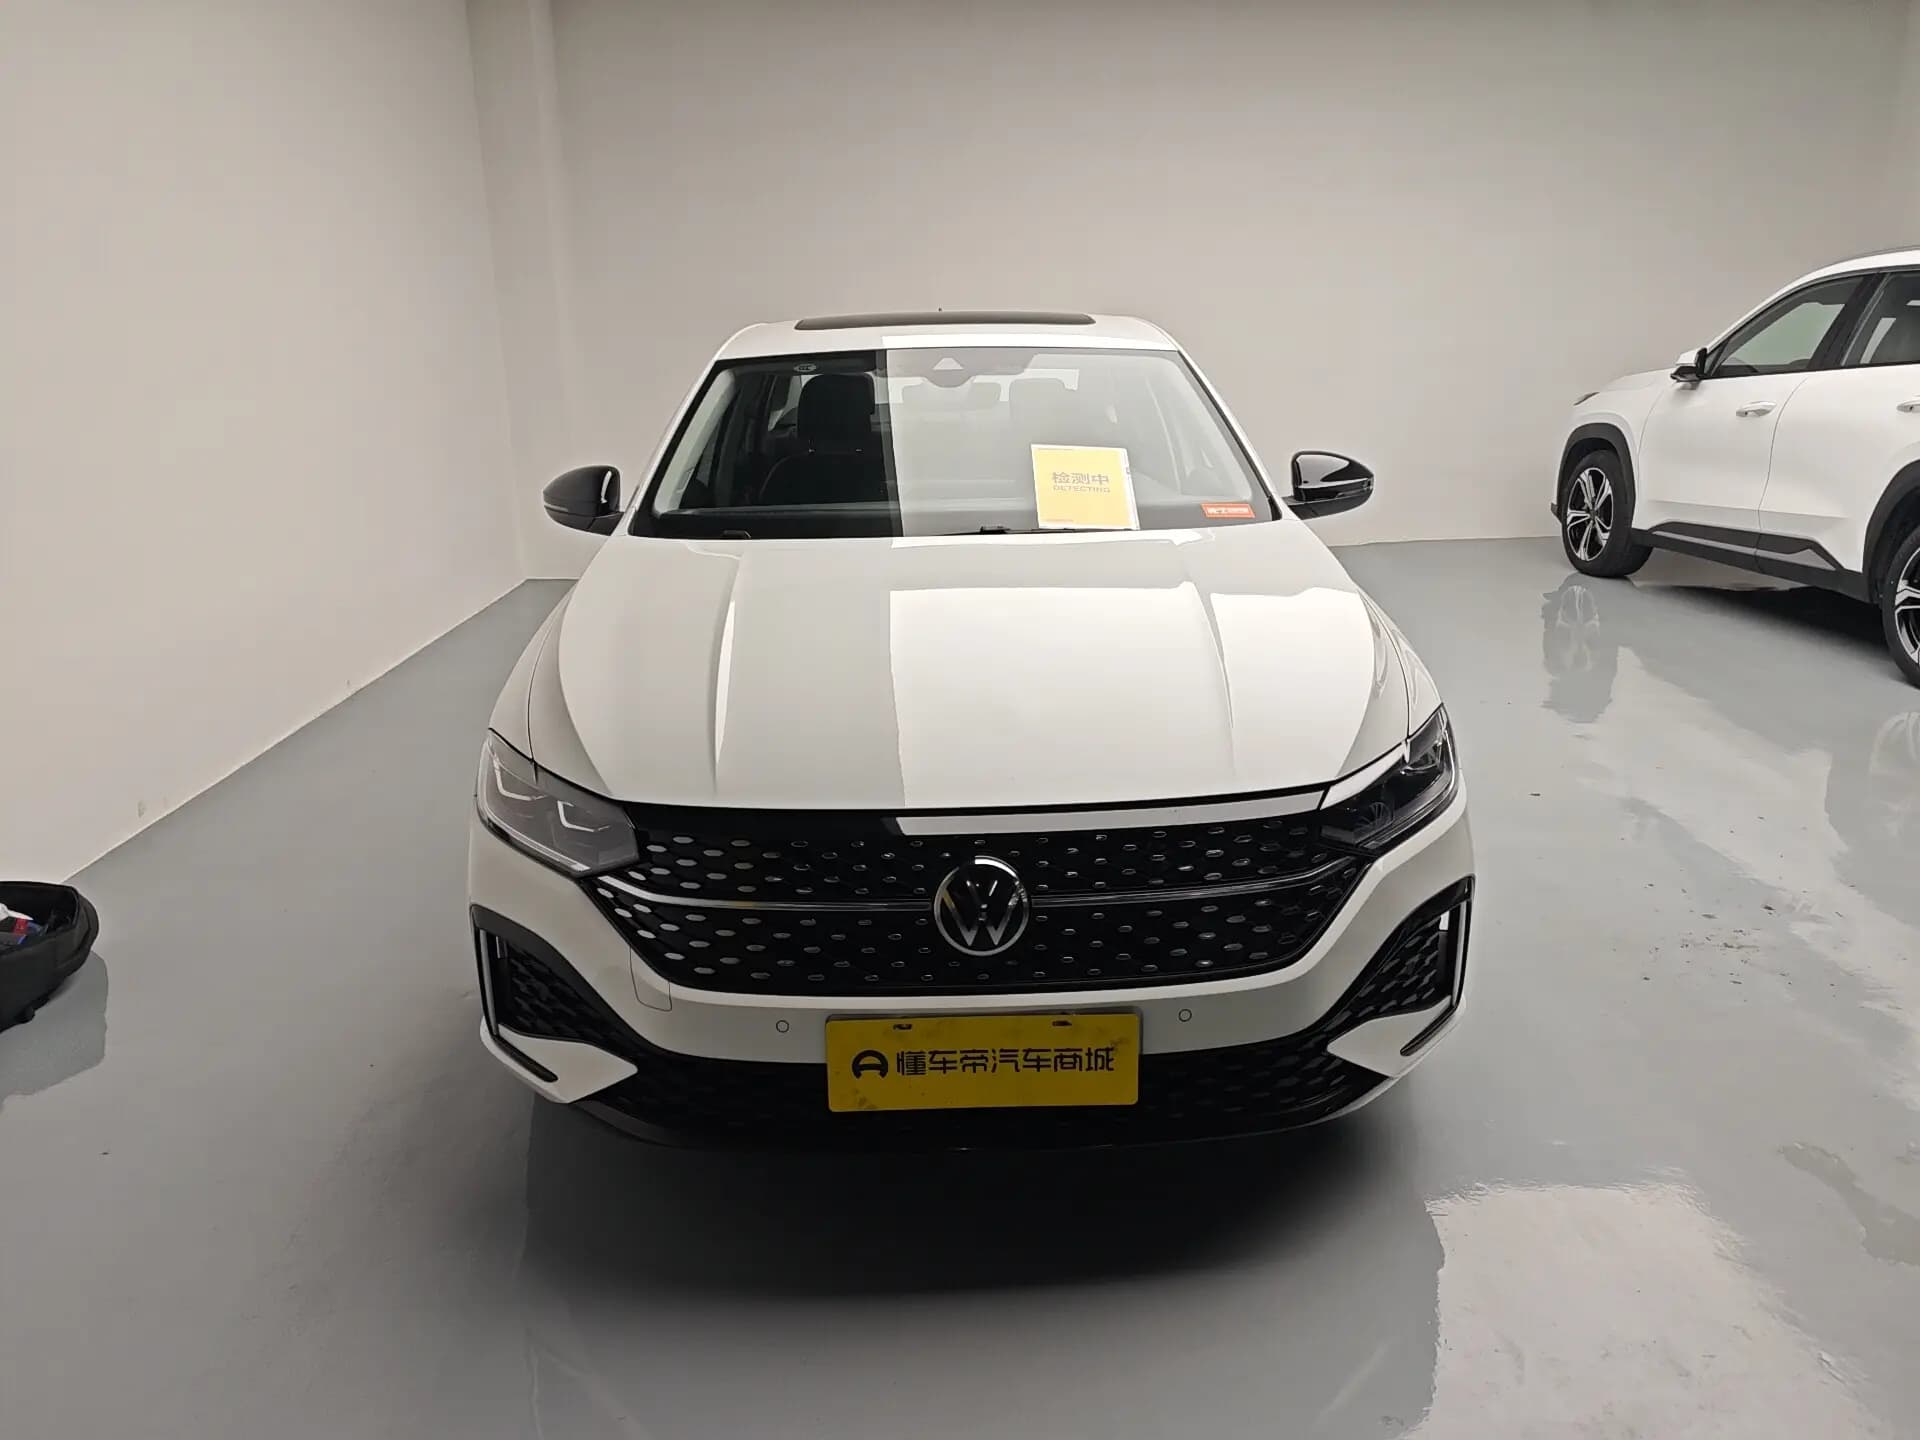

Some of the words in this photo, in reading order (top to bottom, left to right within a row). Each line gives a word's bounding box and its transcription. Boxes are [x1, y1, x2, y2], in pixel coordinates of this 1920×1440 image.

[1052, 471, 1109, 485] 检测中
[1053, 485, 1111, 493] DETECTING
[896, 1047, 1114, 1076] 懂车帝汽车商城
